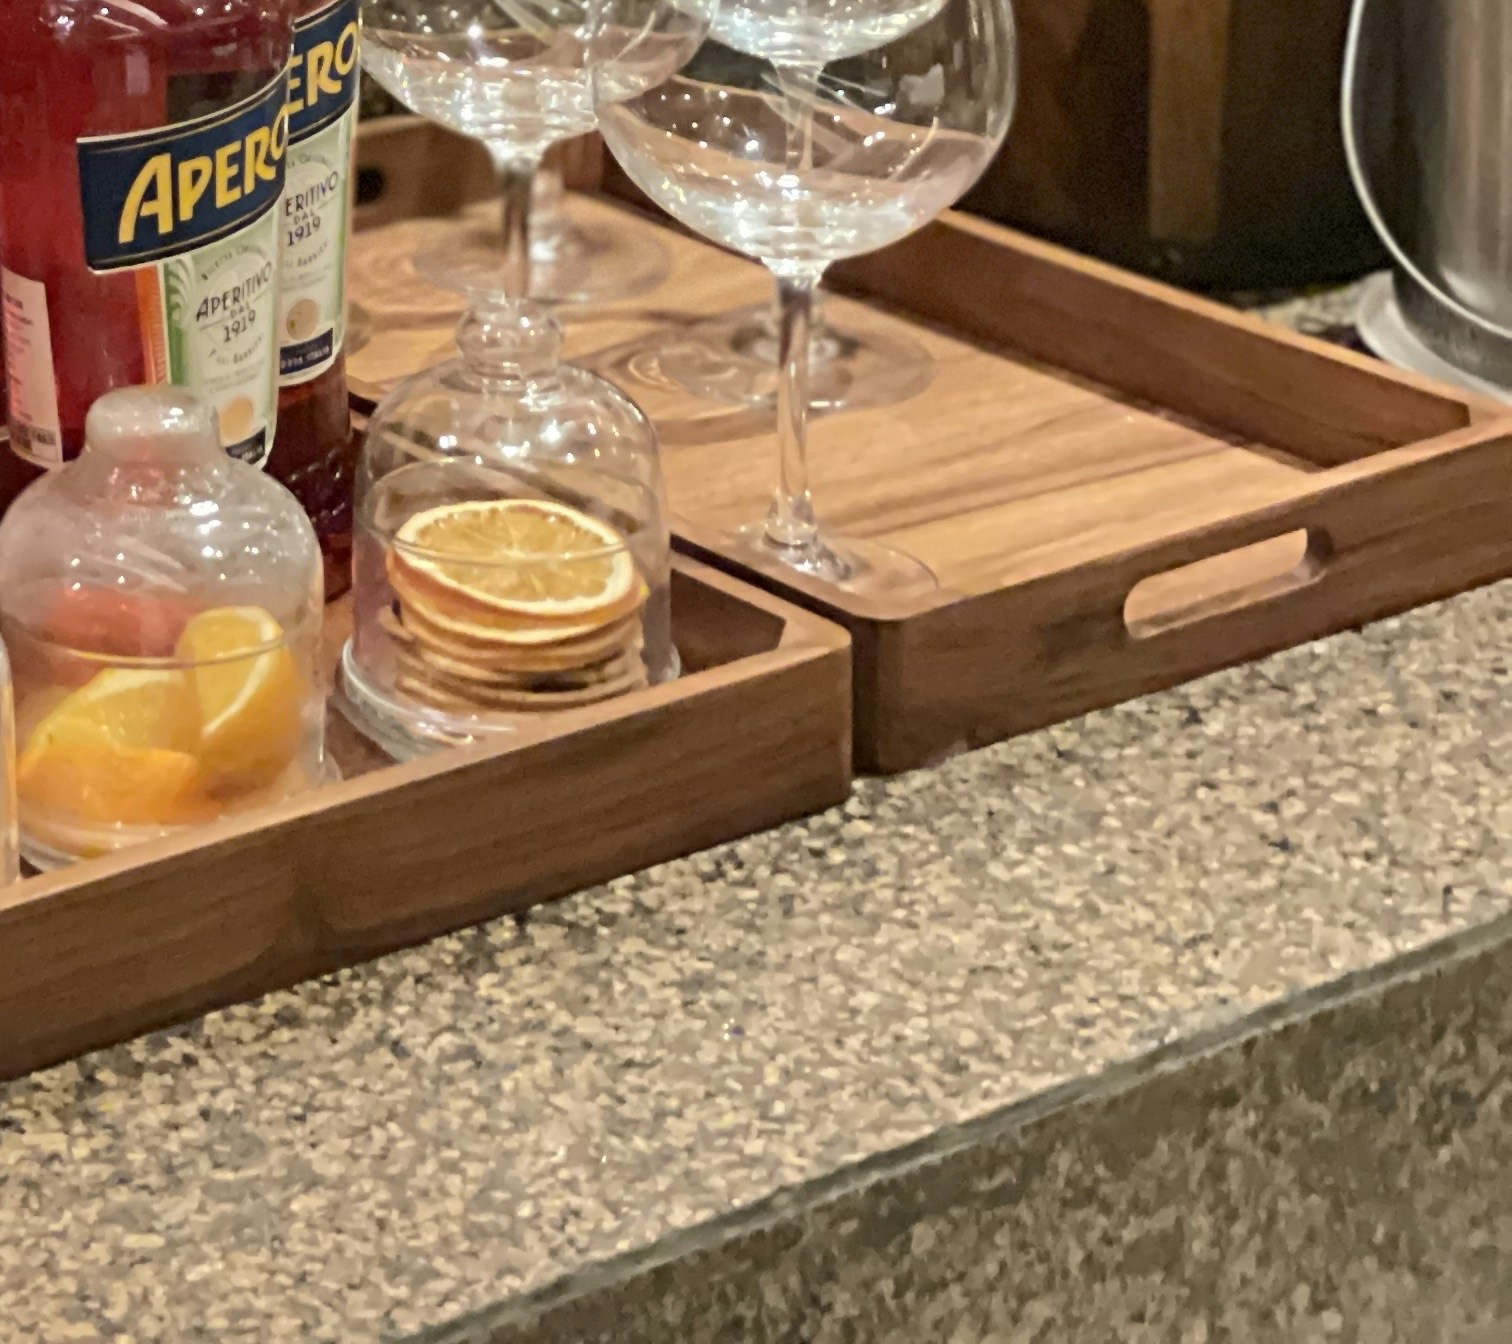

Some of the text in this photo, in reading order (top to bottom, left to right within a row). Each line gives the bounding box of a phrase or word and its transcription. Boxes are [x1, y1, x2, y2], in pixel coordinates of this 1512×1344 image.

[287, 21, 359, 115] ERO
[118, 102, 289, 245] APERO
[285, 170, 339, 217] ERITIVO
[287, 216, 322, 248] 1919
[195, 261, 273, 323] APERITIVO
[223, 309, 258, 343] 1919
